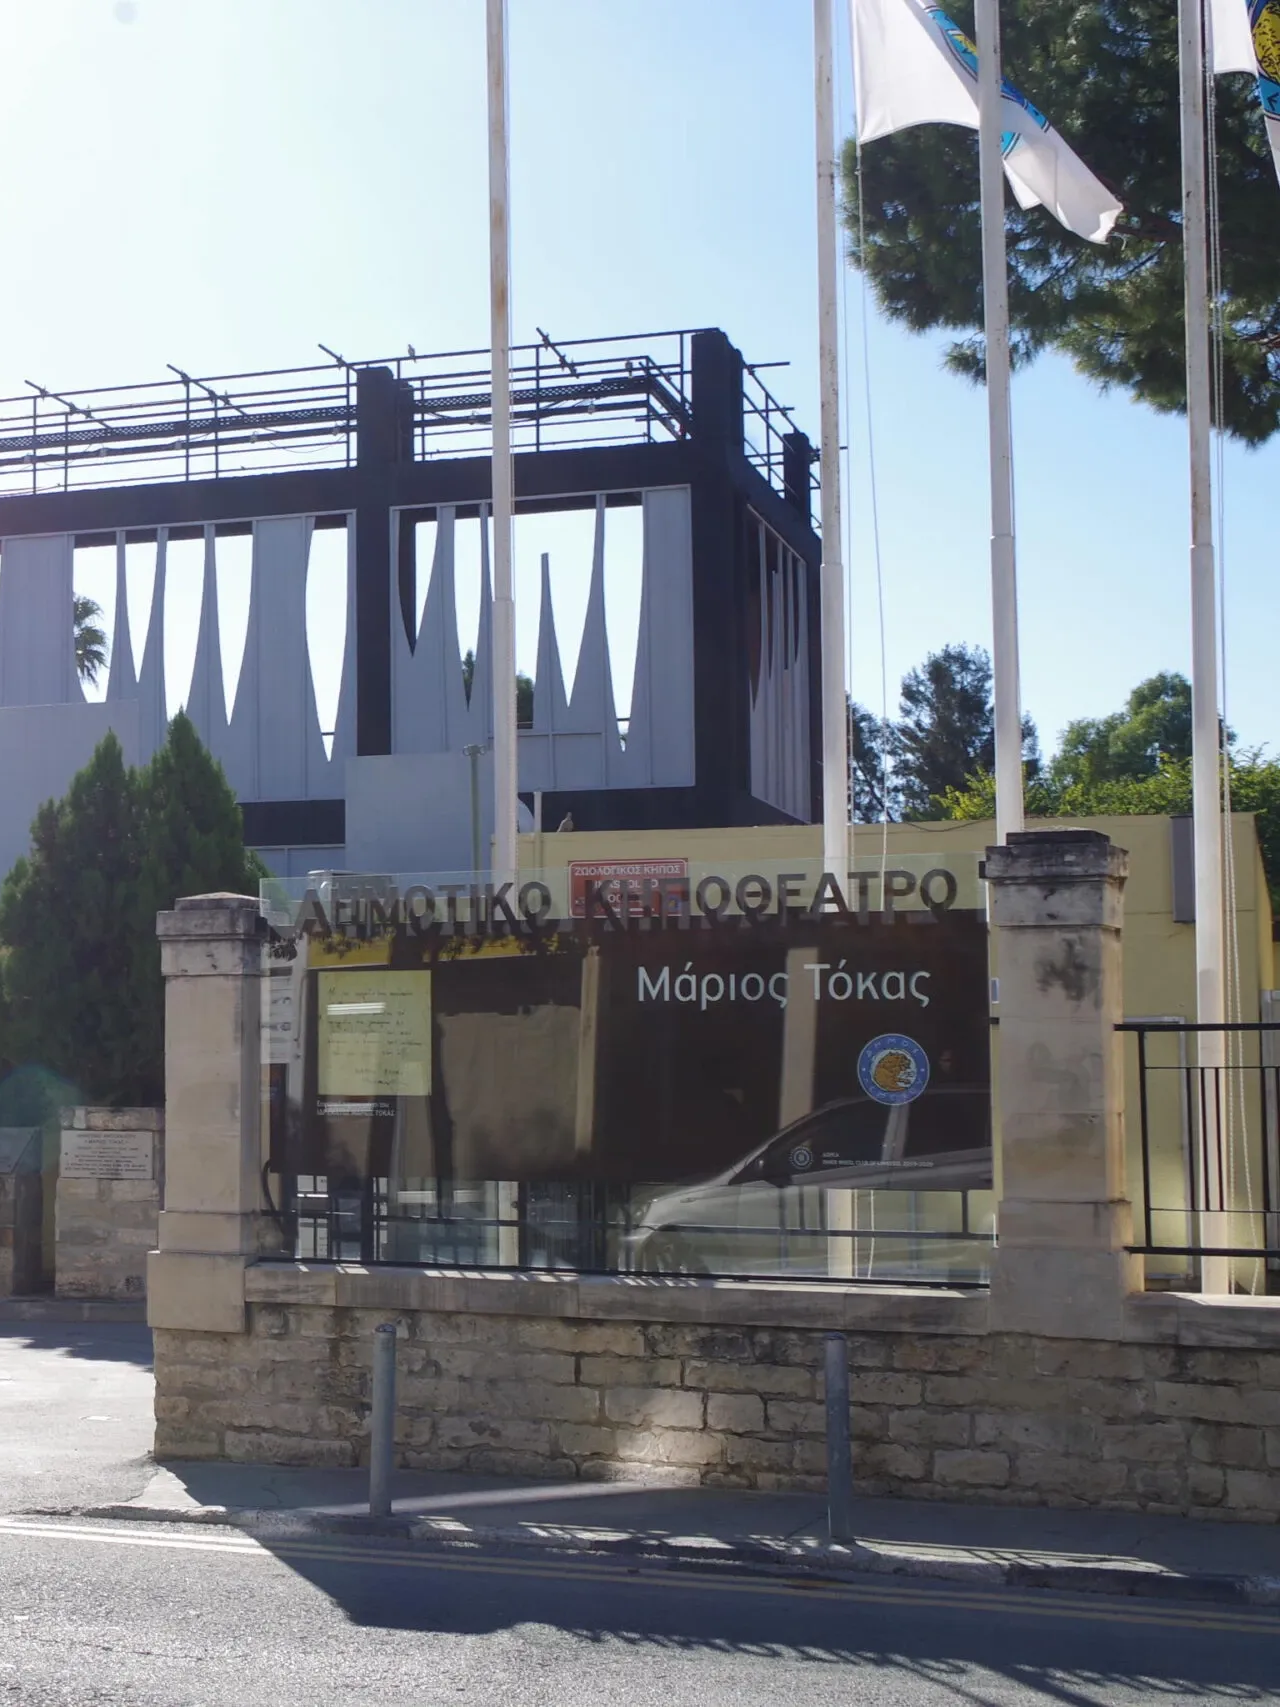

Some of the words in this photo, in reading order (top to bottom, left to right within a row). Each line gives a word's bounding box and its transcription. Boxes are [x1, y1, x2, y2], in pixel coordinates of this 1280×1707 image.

[643, 864, 680, 874] ΚΗΠΟΣ
[586, 868, 958, 926] ΚΗΠΟΘΕΑΤΡΟ
[637, 961, 790, 1011] Μάριος
[803, 959, 931, 1008] Τόκας
